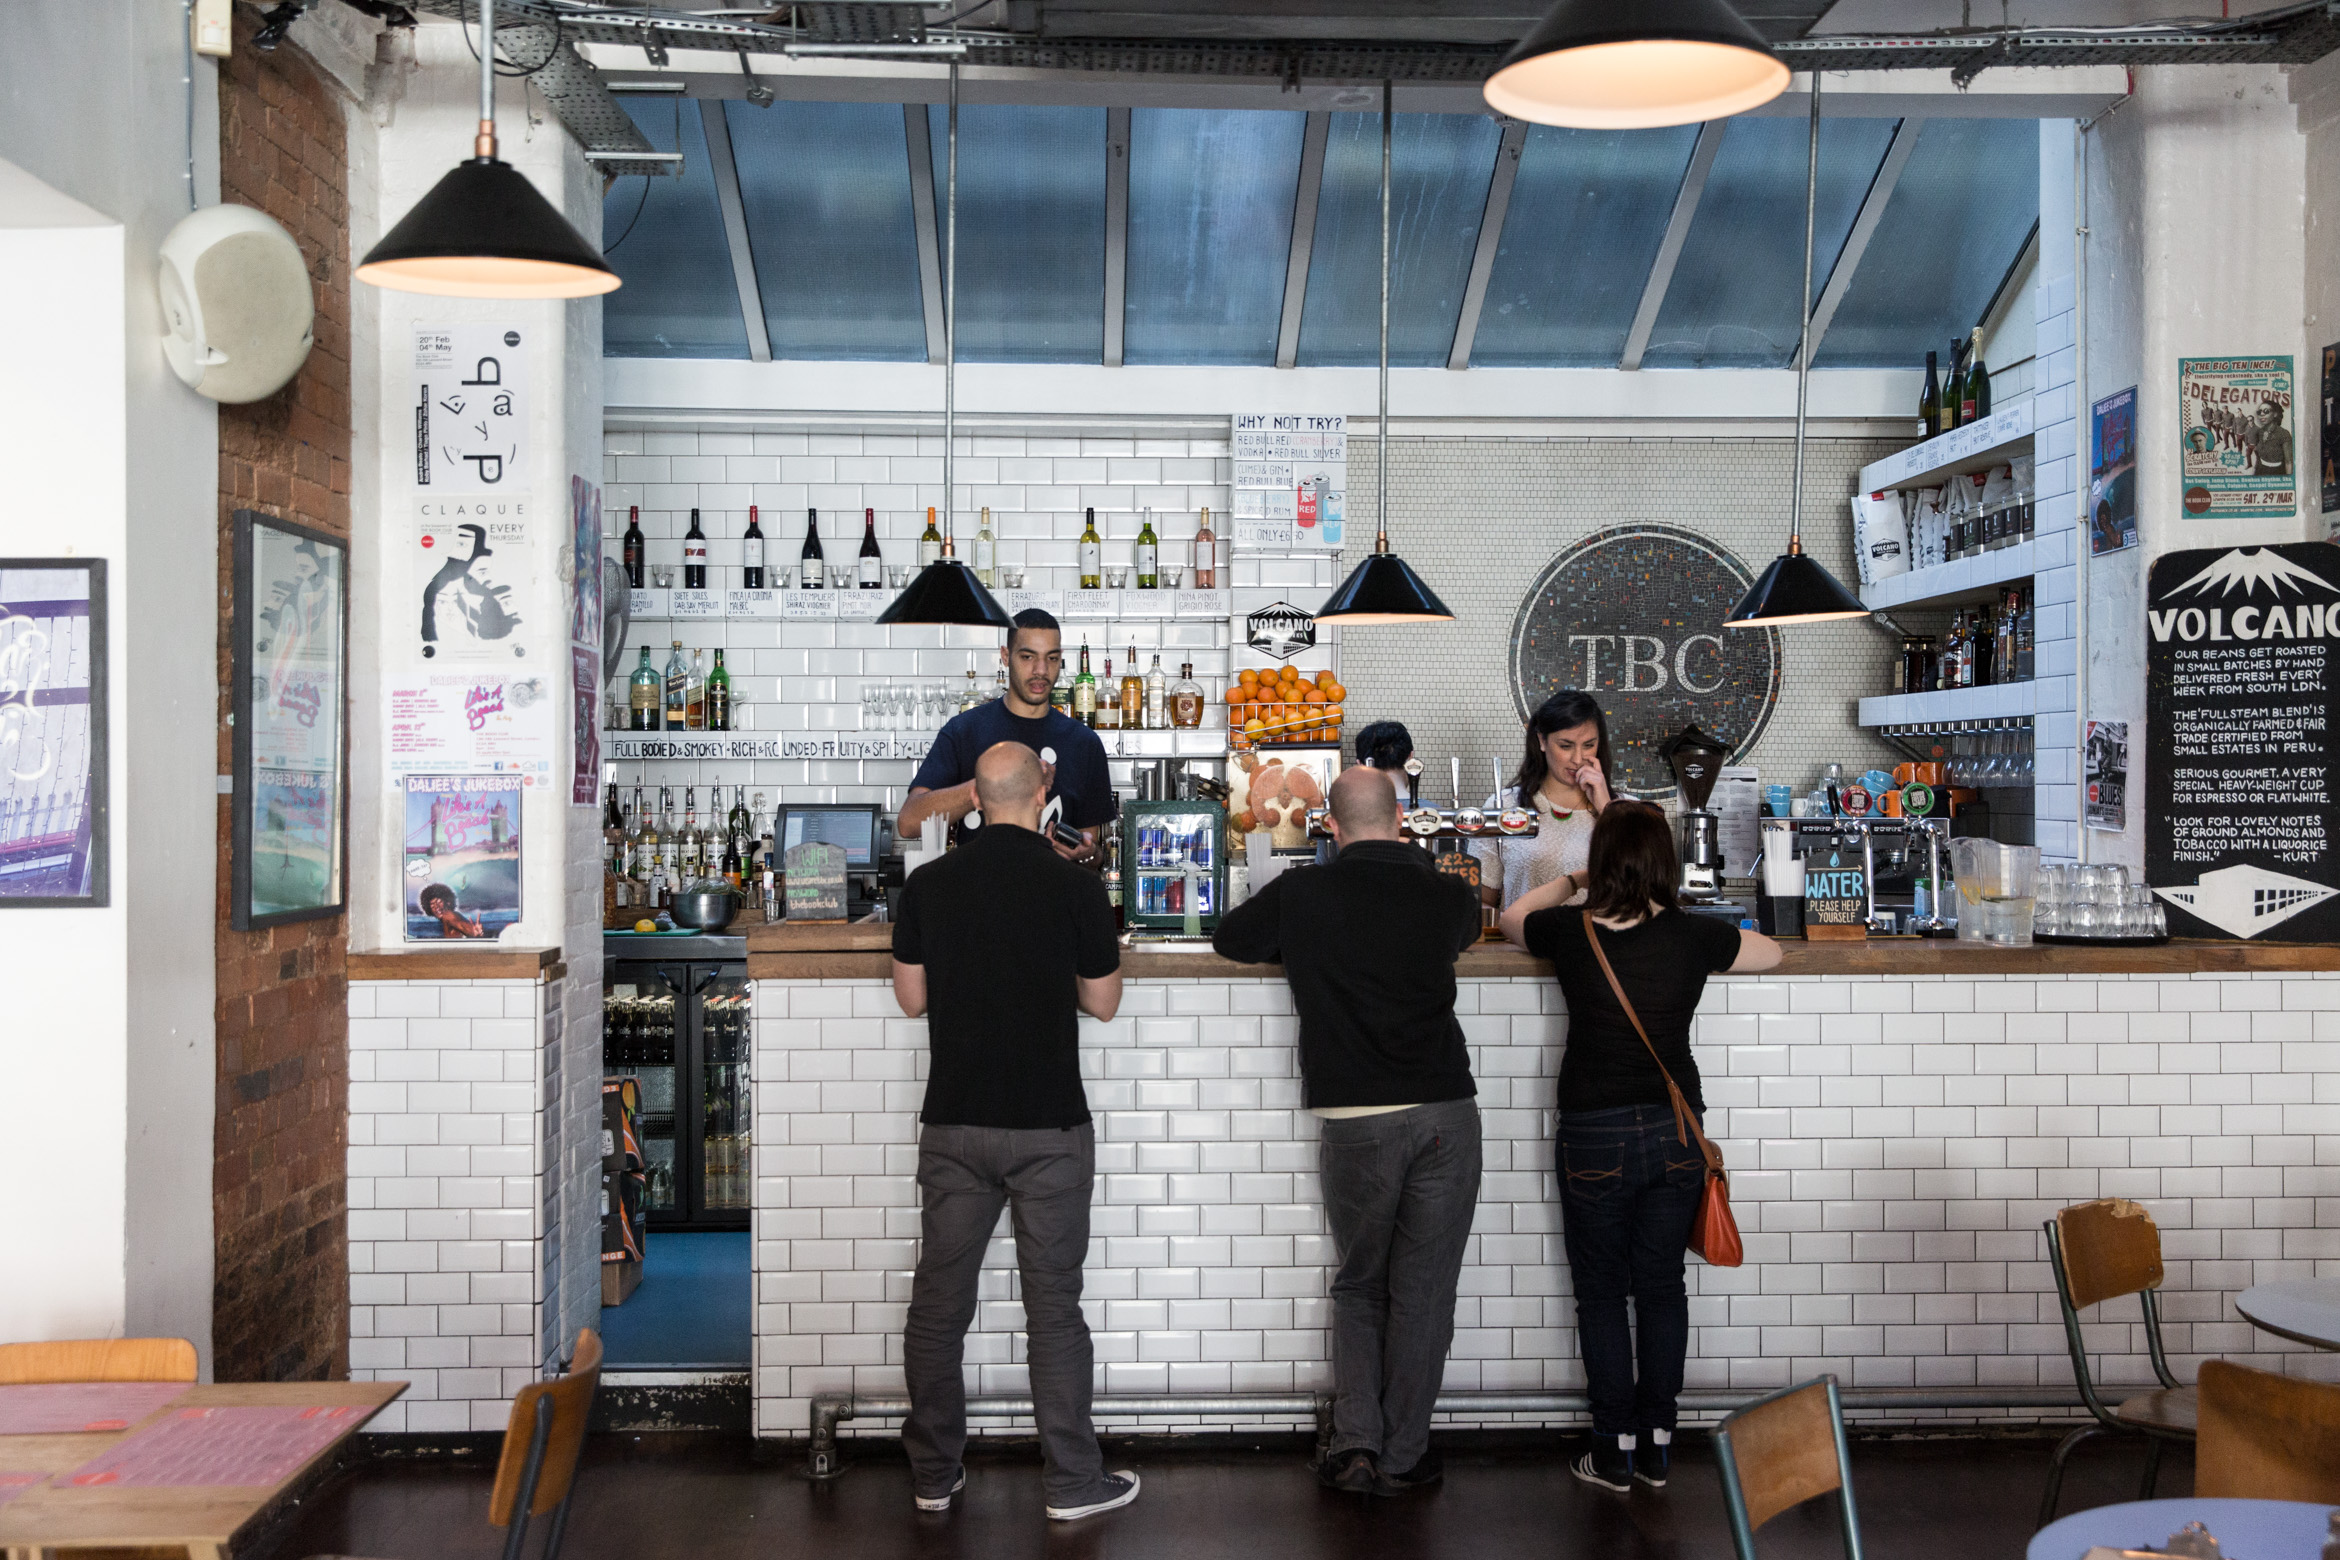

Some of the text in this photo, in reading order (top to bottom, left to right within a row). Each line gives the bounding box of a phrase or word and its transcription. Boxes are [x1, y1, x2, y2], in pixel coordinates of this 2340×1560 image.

[436, 344, 452, 352] May
[2195, 360, 2275, 371] THE BIG TEN INCH!
[2191, 382, 2290, 407] DELEGATORS
[1238, 416, 1342, 431] WHY NOT TRY?
[1238, 436, 1255, 446] RED
[1256, 436, 1274, 446] BULL
[1276, 436, 1292, 446] RED
[1238, 448, 1341, 459] VODKA RED BULL SILVER
[1270, 466, 1284, 474] GIN
[1238, 477, 1255, 486] RED
[1276, 477, 1293, 487] BLUE
[2243, 492, 2293, 505] SAT. MAR
[421, 504, 524, 516] CLAQUE
[1274, 508, 1291, 516] RUM
[1299, 505, 1316, 513] RED
[490, 524, 525, 533] EVERY
[1238, 529, 1277, 541] ALL ONLY
[1872, 543, 1899, 553] VOLCANO
[675, 592, 709, 600] SIETE SOLES
[786, 593, 799, 601] LES
[1067, 591, 1109, 600] FIRST FLEET
[1126, 592, 1166, 600] FOXWOOD
[1178, 592, 1218, 601] NINA PINOT
[730, 602, 749, 610] MALBEC
[1067, 601, 1111, 609] CHARDONNAY
[1178, 602, 1203, 610] GRIGIO
[1249, 618, 1314, 632] VOLCANO
[2175, 646, 2326, 659] OUR BEANS GET ROASTED
[1568, 634, 1728, 694] TBC
[2174, 658, 2325, 672] IN SMALL BATCHES BY HAND
[2174, 669, 2323, 684] DELIVERED FRESH EVERY
[2174, 681, 2327, 696] WEEK FROM SOUTH LDN.
[2173, 710, 2197, 720] THE
[2314, 705, 2325, 715] IS
[2174, 718, 2326, 732] ORGANICALLY FARMED FAIR
[2174, 731, 2303, 743] TRADE CERTIFIED FROM
[615, 743, 640, 757] FULL
[642, 742, 677, 757] BODIED
[684, 742, 725, 757] SMOKEY
[732, 742, 757, 757] RICH
[758, 746, 764, 754] &
[765, 742, 817, 757] ROUNDED
[822, 742, 864, 758] FRUITY
[865, 746, 871, 754] &
[873, 742, 908, 757] SPICY
[2174, 742, 2324, 756] SMALL ESTATES IN PERU.
[2174, 769, 2219, 779] SERIOUS
[2282, 768, 2290, 777] A
[2292, 767, 2327, 778] VERY
[464, 778, 522, 792] JUKEBOX
[2174, 779, 2325, 791] SPECIAL HEAVY-WEIGHT CUP
[2099, 784, 2122, 806] BLUES
[2173, 793, 2192, 803] FOR
[2196, 793, 2246, 803] ESPRESSO
[2249, 792, 2264, 803] OR
[2208, 816, 2231, 826] FOR
[2235, 816, 2278, 827] LOVELY
[2281, 815, 2321, 826] NOTES
[2174, 827, 2326, 838] OF GROUND ALMONDS AND
[2174, 838, 2328, 850] TOBACCO WITH A LIQUORICE
[801, 848, 829, 866] WIFI
[1805, 872, 1864, 899] WATER
[790, 897, 838, 910] thebookclub
[1842, 900, 1861, 912] HELP
[1818, 912, 1856, 924] YOURSELF
[603, 1252, 623, 1260] NGE
